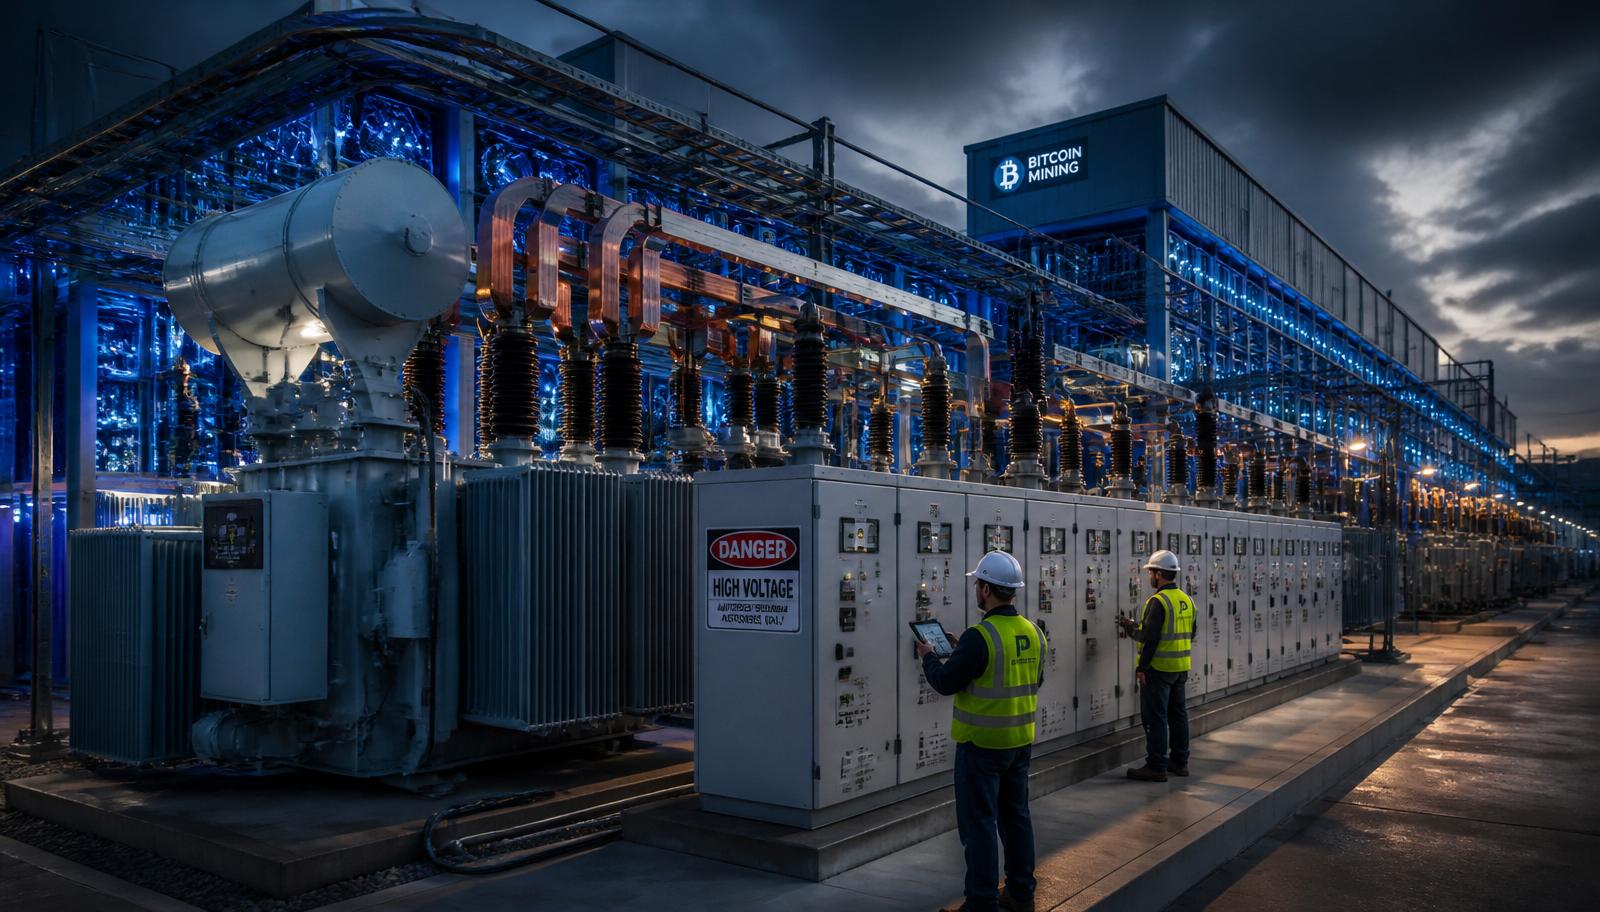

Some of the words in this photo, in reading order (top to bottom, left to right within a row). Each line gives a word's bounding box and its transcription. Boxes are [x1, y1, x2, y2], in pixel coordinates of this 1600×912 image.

[1028, 145, 1082, 169] BITCOIN
[1028, 161, 1079, 183] MINING
[719, 539, 788, 559] DANGER
[713, 577, 740, 598] HIGH
[743, 578, 794, 600] VOLTAGE
[1015, 634, 1031, 657] P
